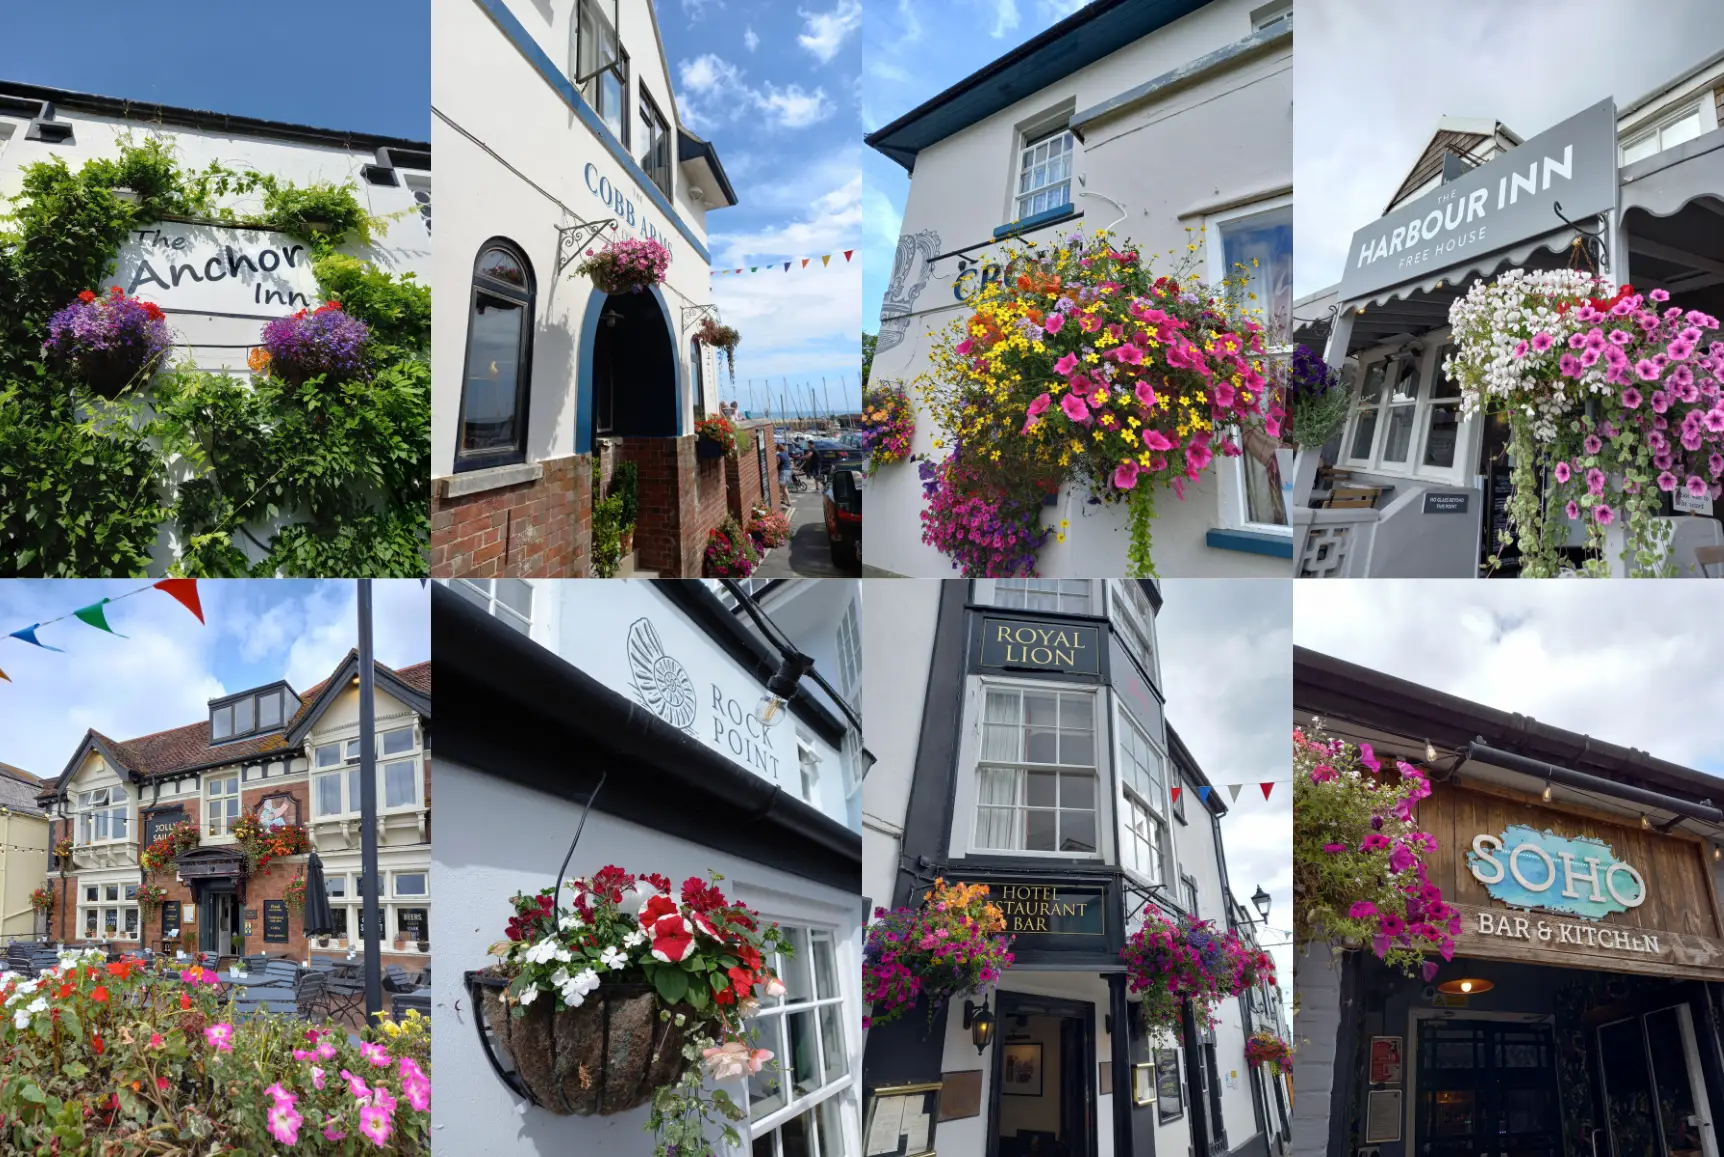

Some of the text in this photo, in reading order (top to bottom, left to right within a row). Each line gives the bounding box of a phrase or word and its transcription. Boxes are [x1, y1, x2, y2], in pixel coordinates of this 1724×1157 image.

[584, 162, 636, 228] COBB
[1357, 144, 1573, 269] HARBOUR INN
[1437, 189, 1457, 205] THE
[132, 229, 186, 250] The
[1398, 226, 1487, 269] FREE HOUSE
[128, 244, 304, 294] Anchor
[254, 282, 310, 307] Inn
[997, 625, 1086, 649] ROYAL
[1005, 644, 1075, 666] LION
[711, 682, 774, 750] ROCK
[712, 715, 779, 779] POINT
[1472, 834, 1646, 908] SOHO
[1003, 886, 1060, 901] HOTEL
[987, 900, 1088, 917] STAURANT
[1014, 917, 1048, 931] BAR
[1478, 912, 1530, 939] BAR
[1537, 920, 1553, 941] &
